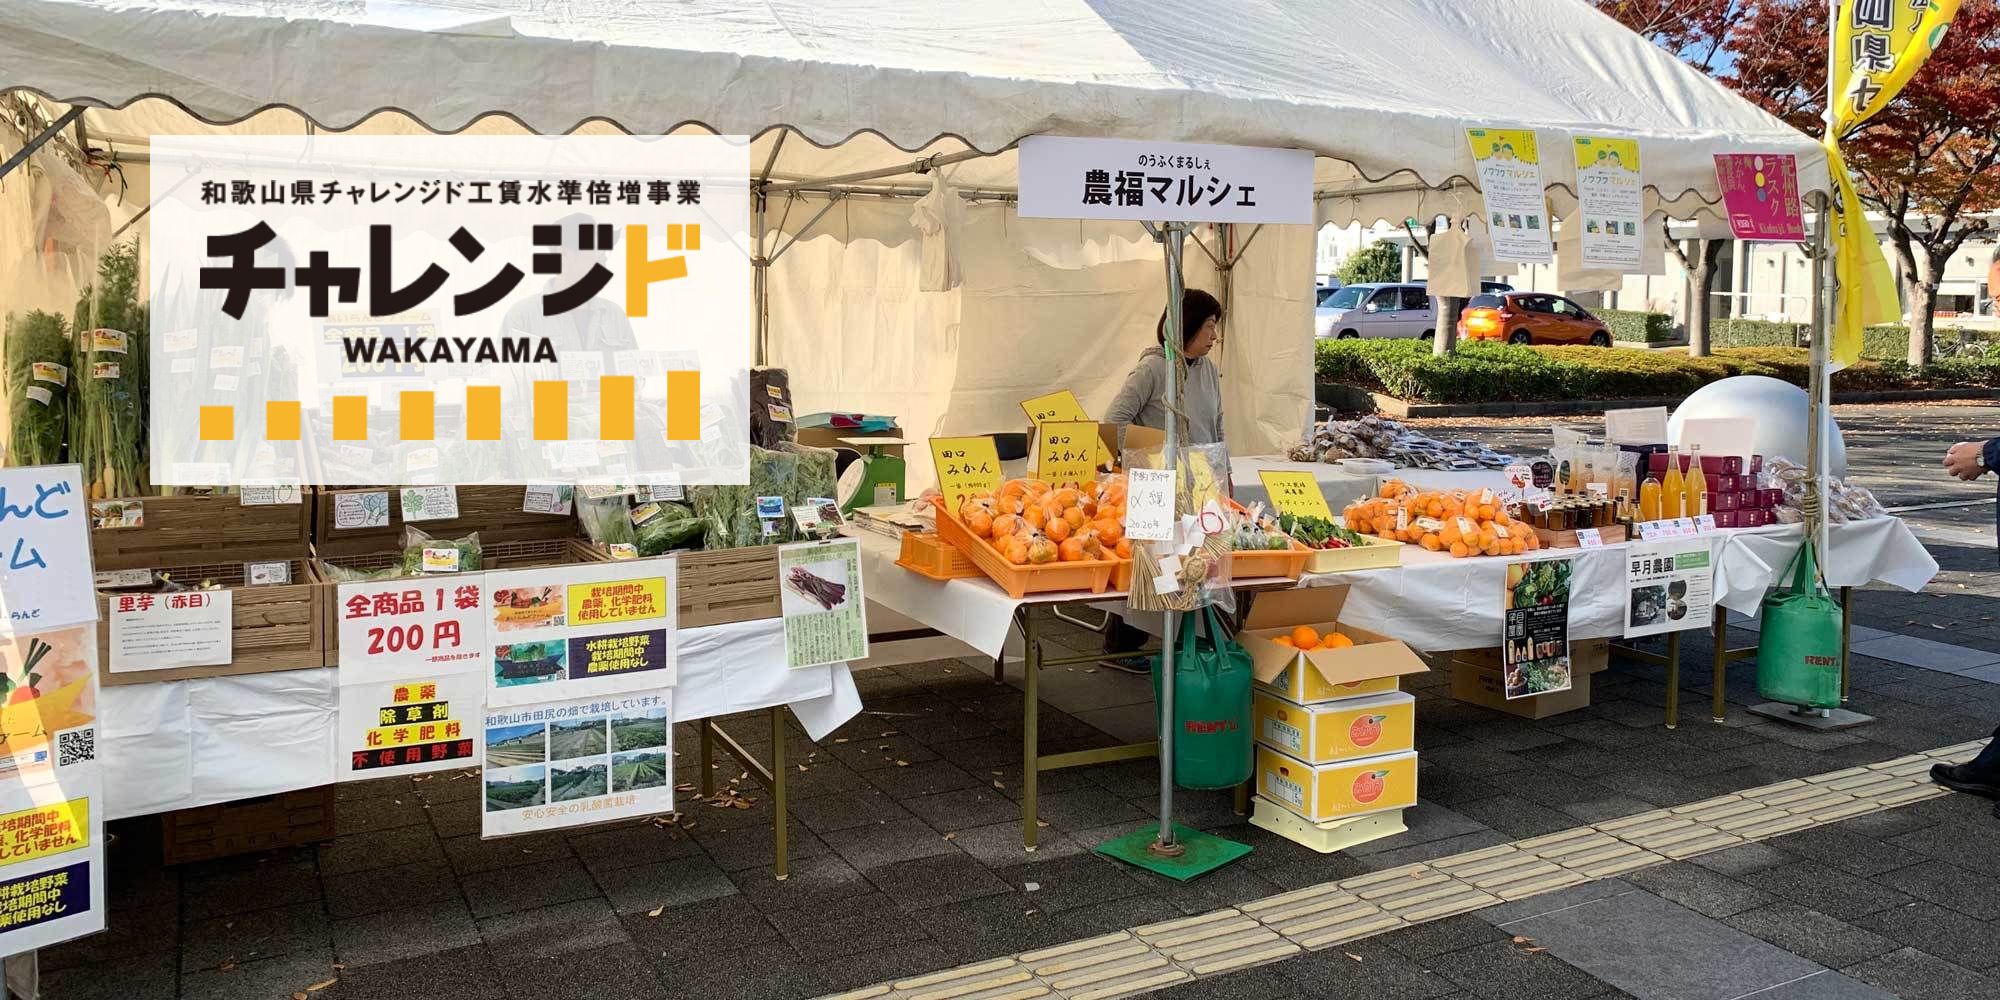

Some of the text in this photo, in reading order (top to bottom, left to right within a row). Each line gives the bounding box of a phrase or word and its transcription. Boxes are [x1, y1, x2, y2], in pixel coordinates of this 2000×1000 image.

[1138, 154, 1211, 170] のうふくまるしぇ
[1082, 169, 1256, 207] 農福マルシェ
[1765, 157, 1779, 217] ラスク
[1036, 410, 1056, 420] 田口
[1049, 436, 1070, 445] 田口
[942, 450, 965, 458] 田口
[1048, 449, 1088, 463] みかん
[947, 462, 992, 475] みかん
[1631, 557, 1674, 576] 早月農園
[591, 584, 644, 598] 栽培期間中
[118, 592, 212, 613] 里芋（赤目）
[11, 609, 40, 621] らんど
[578, 606, 657, 621] 使用していません
[586, 634, 650, 651] 水耕栽培野菜
[591, 647, 645, 662] 栽培期間中
[587, 658, 648, 673] 農薬使用なし
[394, 684, 437, 702] 農薬
[380, 703, 448, 725] 除草剤
[485, 695, 667, 727] 和歌山市田尻の畑で栽培しています。
[366, 722, 461, 747] 化学肥料
[353, 742, 473, 768] 不使用野菜
[0, 889, 61, 915] 培期間中
